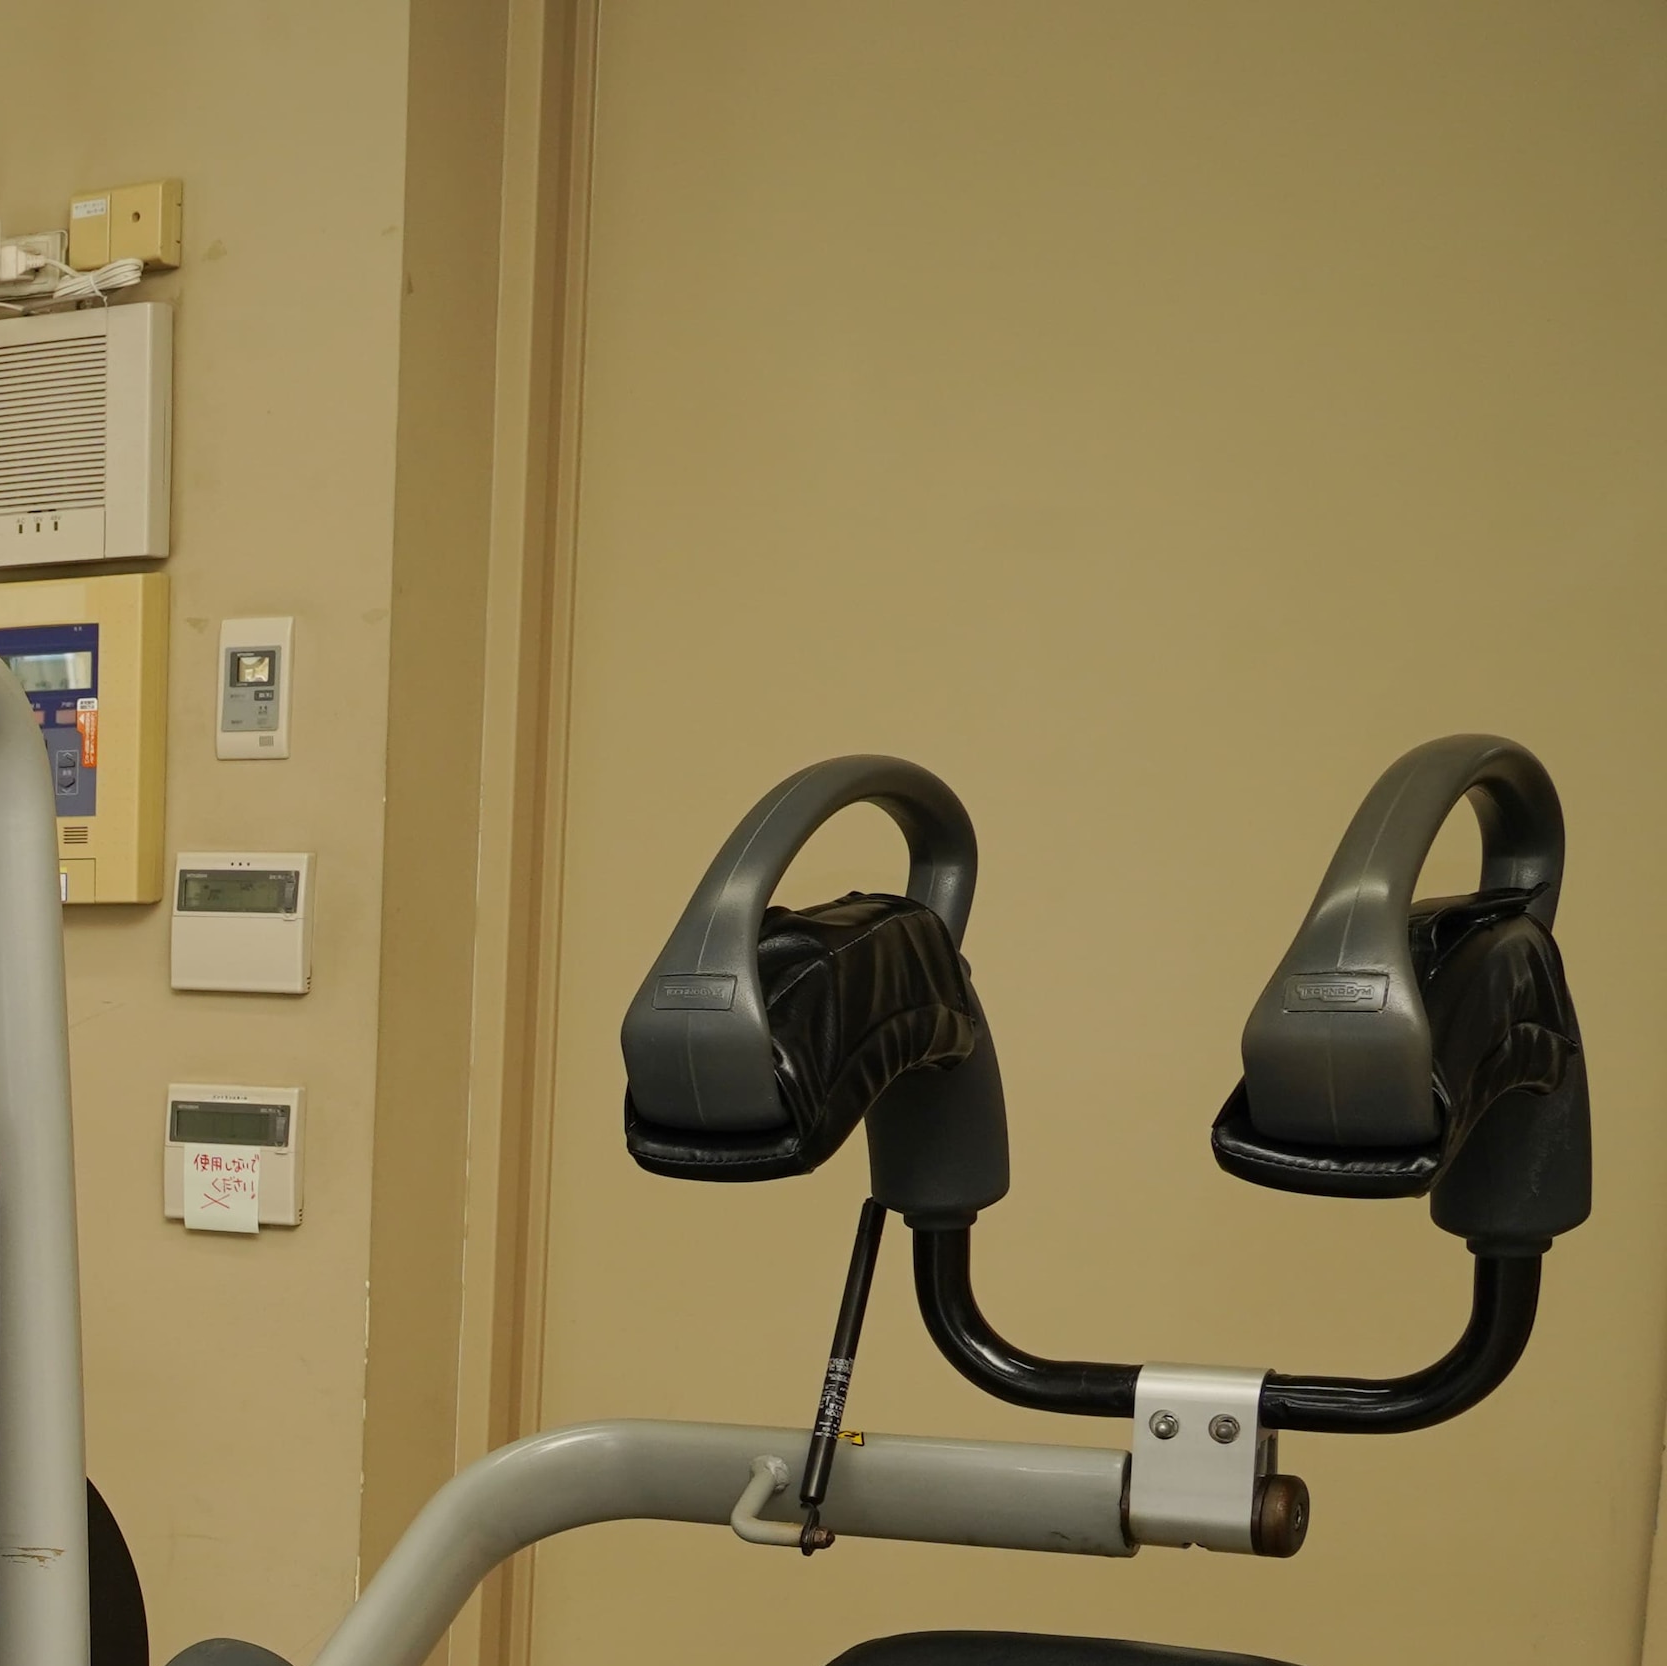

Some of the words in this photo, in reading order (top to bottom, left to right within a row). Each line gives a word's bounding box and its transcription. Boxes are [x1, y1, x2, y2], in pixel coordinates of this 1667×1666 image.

[1297, 982, 1374, 1001] TECHNOGYM
[194, 1154, 260, 1173] 使用しないで
